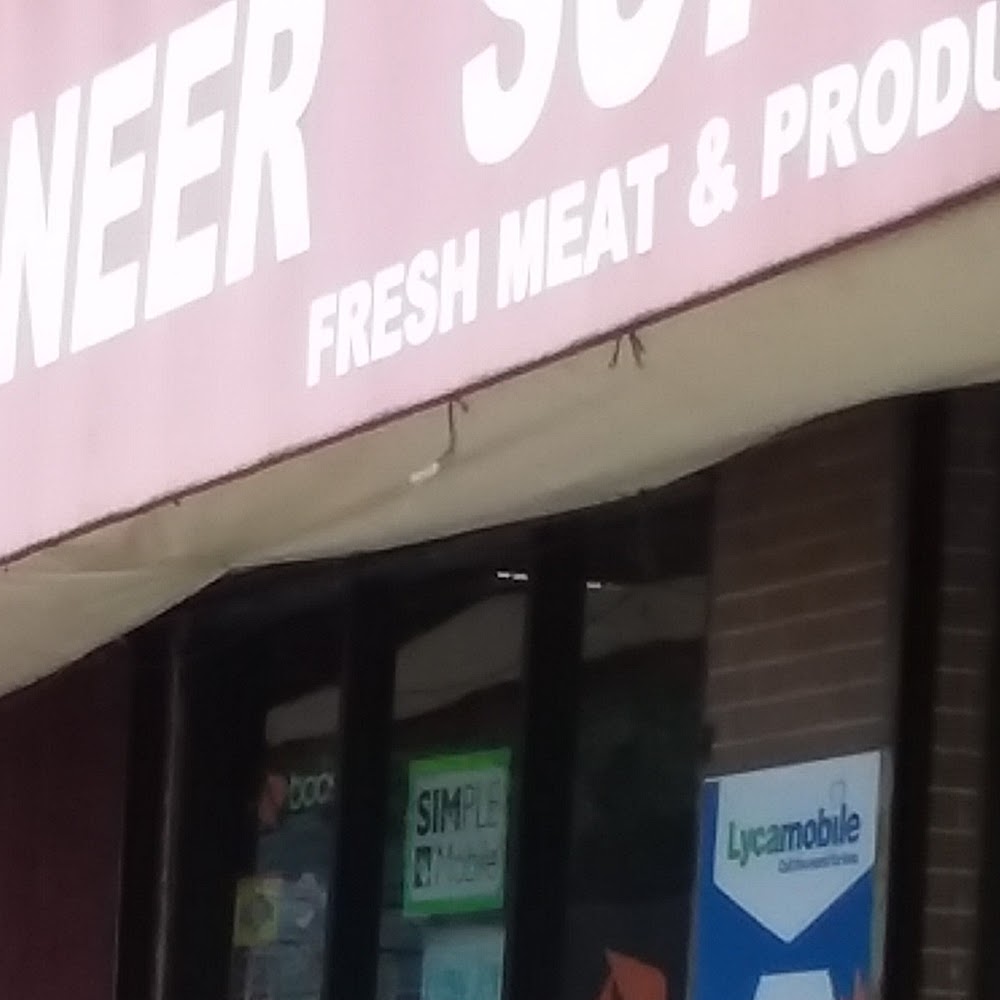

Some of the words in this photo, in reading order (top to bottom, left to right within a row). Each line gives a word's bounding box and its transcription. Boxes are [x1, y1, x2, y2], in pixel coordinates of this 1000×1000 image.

[305, 229, 480, 388] FRESH
[496, 144, 670, 309] MEAT
[688, 115, 737, 227] &
[727, 803, 861, 868] Lycamobile
